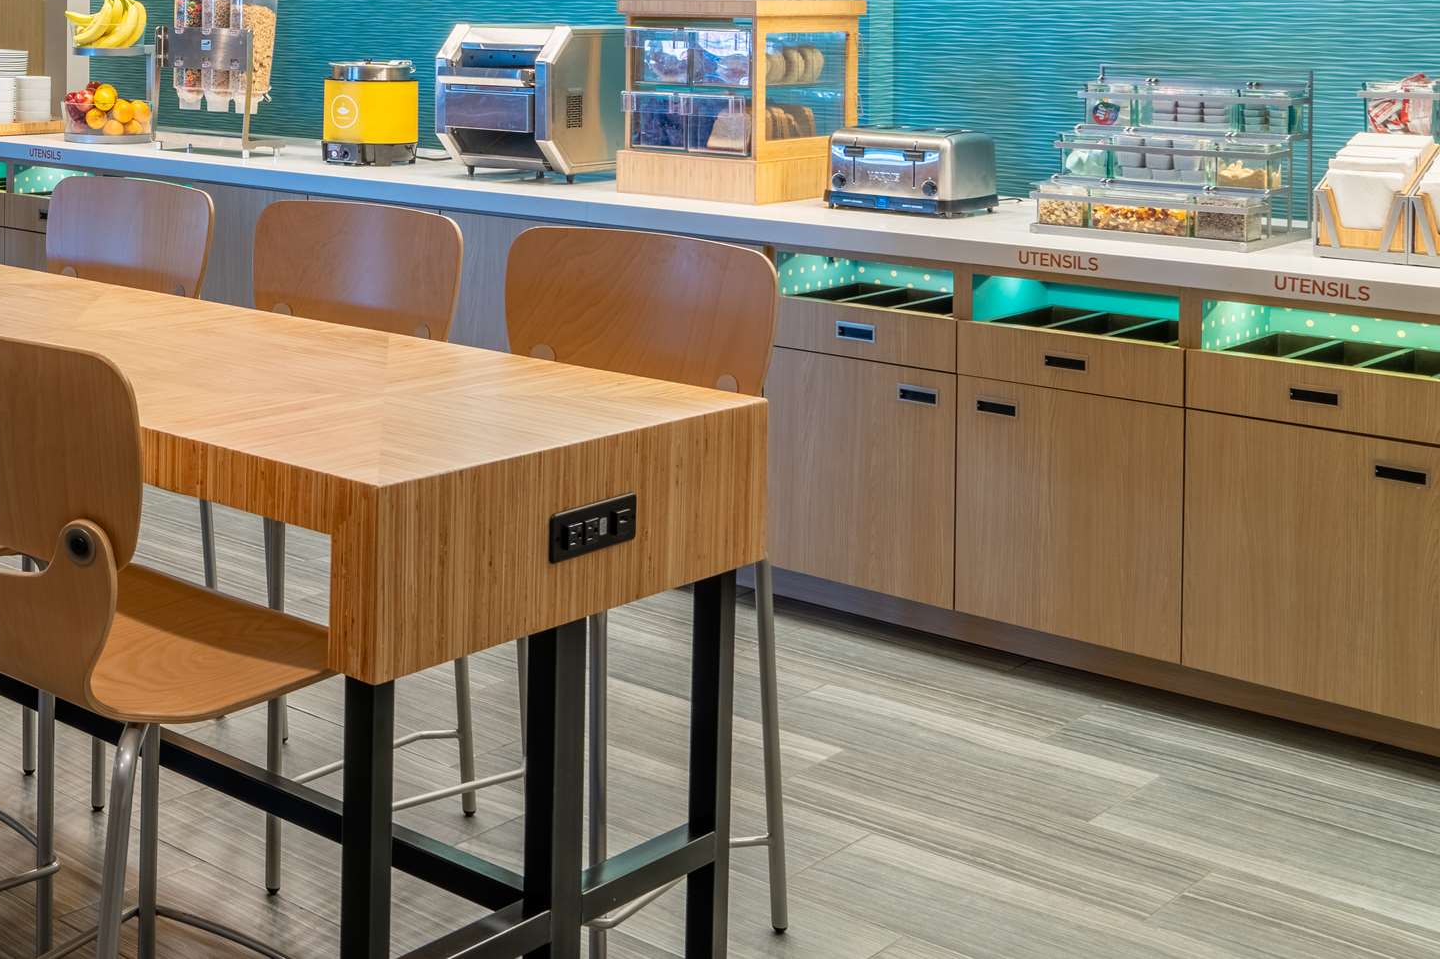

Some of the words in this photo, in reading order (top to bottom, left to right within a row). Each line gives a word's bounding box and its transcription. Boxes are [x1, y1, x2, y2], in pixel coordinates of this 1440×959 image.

[29, 147, 62, 160] UTENSILS
[1018, 249, 1099, 272] UTENSILS
[1274, 274, 1371, 302] UTENSILS
